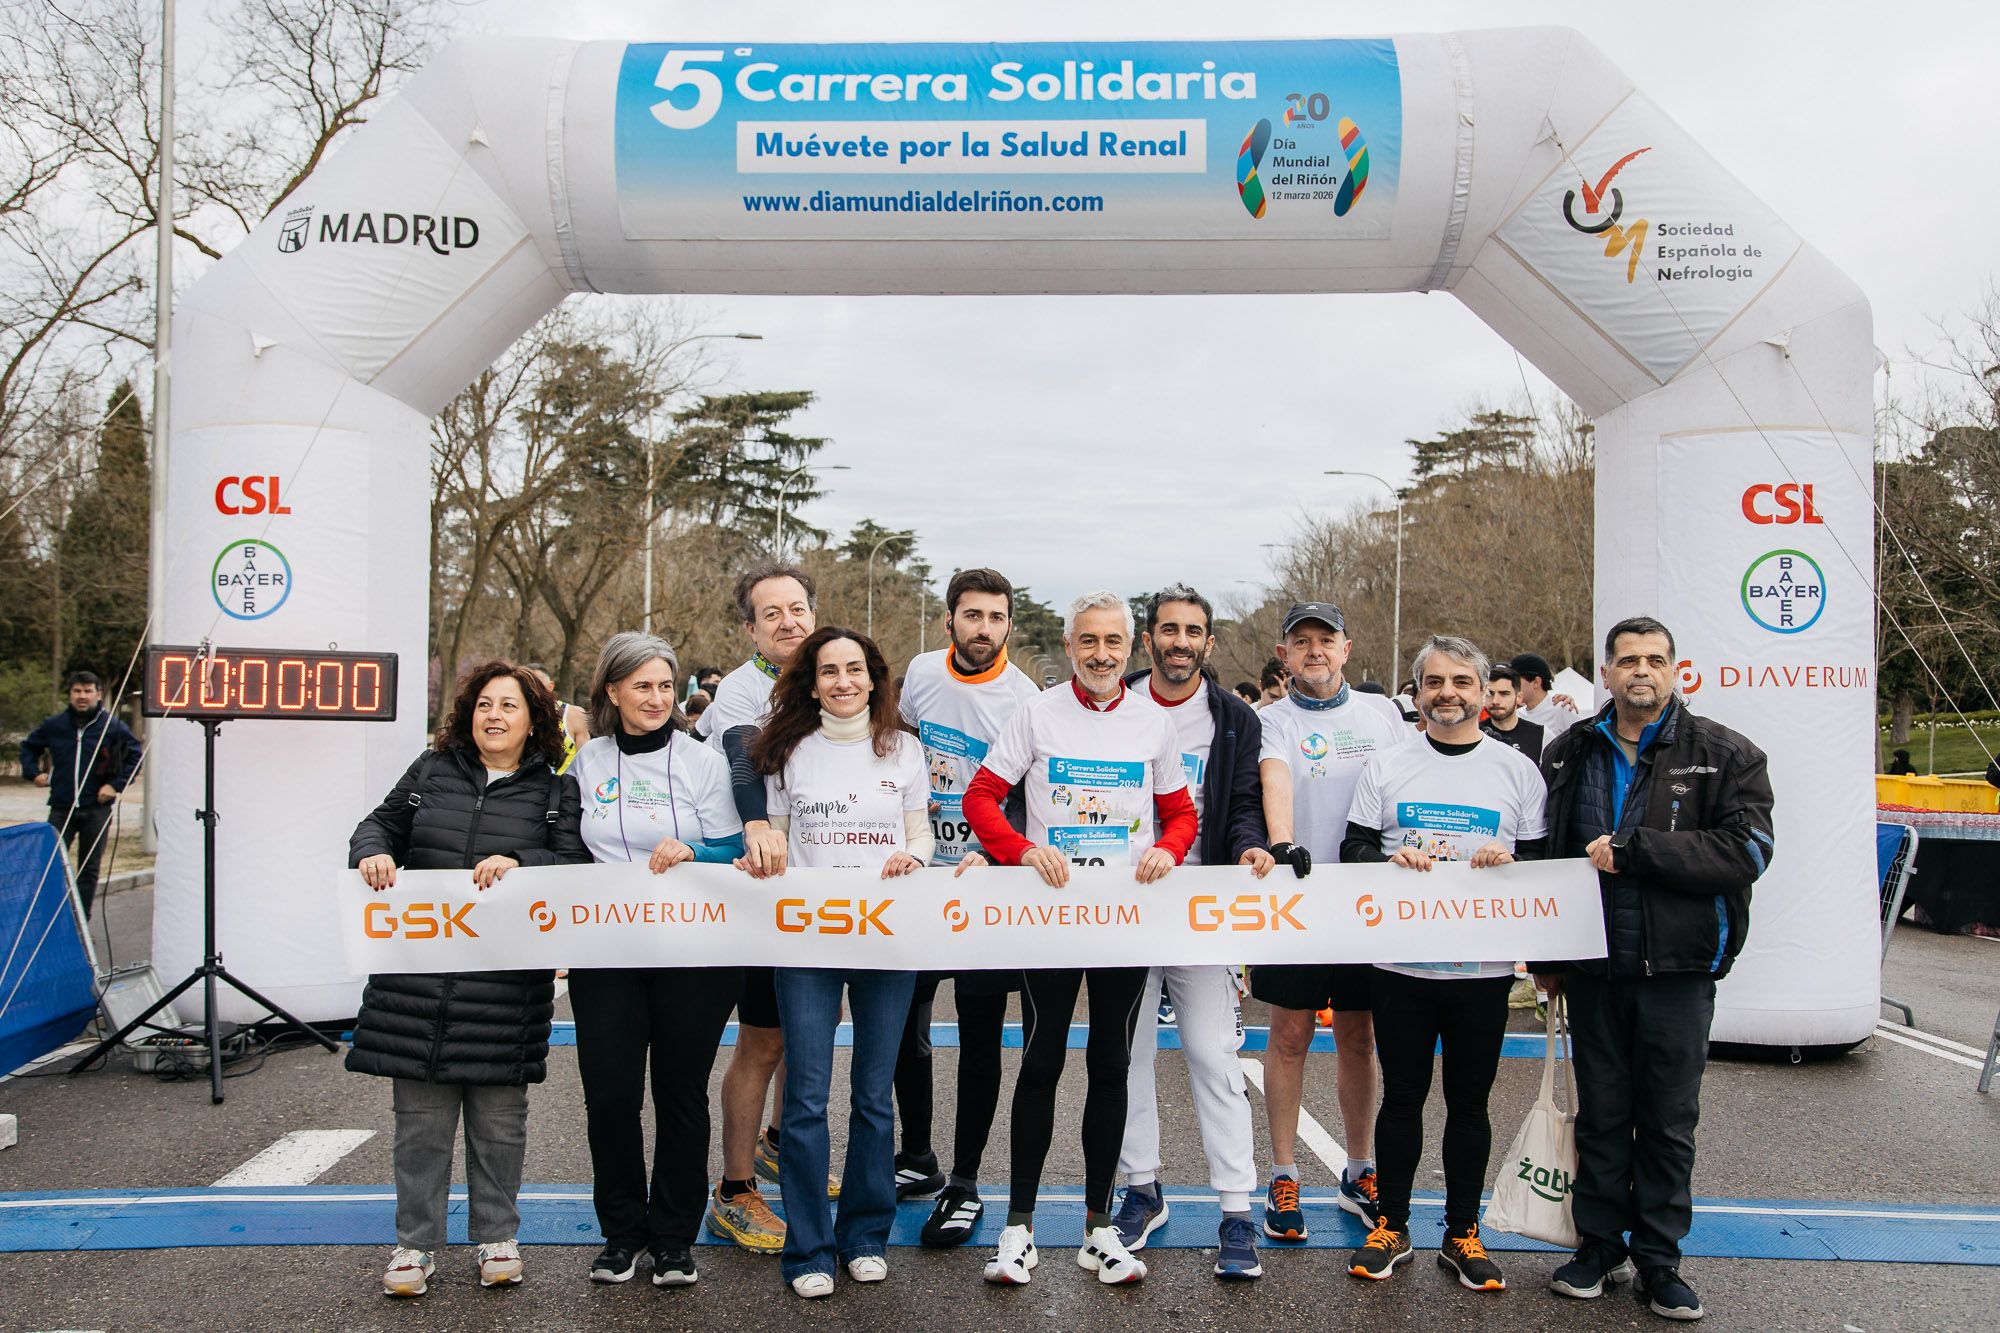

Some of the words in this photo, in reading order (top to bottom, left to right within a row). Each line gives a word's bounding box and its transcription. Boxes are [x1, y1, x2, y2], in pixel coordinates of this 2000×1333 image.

[735, 62, 969, 102] Carrera
[988, 60, 1257, 101] Solidaria
[1284, 93, 1330, 124] 20
[756, 132, 889, 157] Muévete
[900, 138, 952, 164] por
[962, 132, 990, 157] la
[1000, 131, 1088, 157] Salud
[1100, 130, 1187, 156] Renal
[1273, 138, 1297, 150] Día
[1272, 156, 1330, 168] Mundial
[1271, 174, 1293, 185] del
[1296, 173, 1338, 185] Riñón
[743, 190, 1104, 213] www.diamundialdelriñon.com
[1271, 191, 1282, 200] 12
[1284, 191, 1311, 200] marzo
[1312, 190, 1334, 200] 2026
[319, 213, 480, 256] MADRID
[1657, 222, 1734, 236] Sociedad
[1657, 243, 1737, 262] Española
[1743, 244, 1762, 258] de
[1657, 264, 1753, 281] Nefrología
[214, 475, 292, 516] CSL
[1741, 483, 1824, 525] CSL
[218, 573, 284, 586] BAYER
[243, 546, 256, 613] BAYER
[1749, 585, 1820, 598] BAYER
[1779, 557, 1794, 627] BAYER
[1719, 666, 1868, 689] DIAVERUM
[1066, 764, 1095, 772] Carrera
[1096, 765, 1127, 774] Solidaria
[1119, 780, 1140, 788] 2026
[796, 800, 849, 818] Siempre
[1416, 807, 1445, 816] Carrera
[1447, 809, 1479, 819] Solidaria
[805, 820, 829, 829] puede
[831, 819, 856, 828] hacer
[858, 820, 877, 830] algo
[878, 821, 891, 830] por
[932, 819, 972, 842] 109
[1470, 825, 1494, 836] 2026
[1089, 831, 1117, 839] Solidaria
[940, 844, 958, 855] 0117
[363, 902, 479, 939] GSK
[571, 901, 726, 925] DIAVERUM
[775, 898, 894, 936] GSK
[984, 903, 1141, 926] DIAVERUM
[1188, 893, 1306, 932] GSK
[1398, 897, 1559, 920] DIAVERUM
